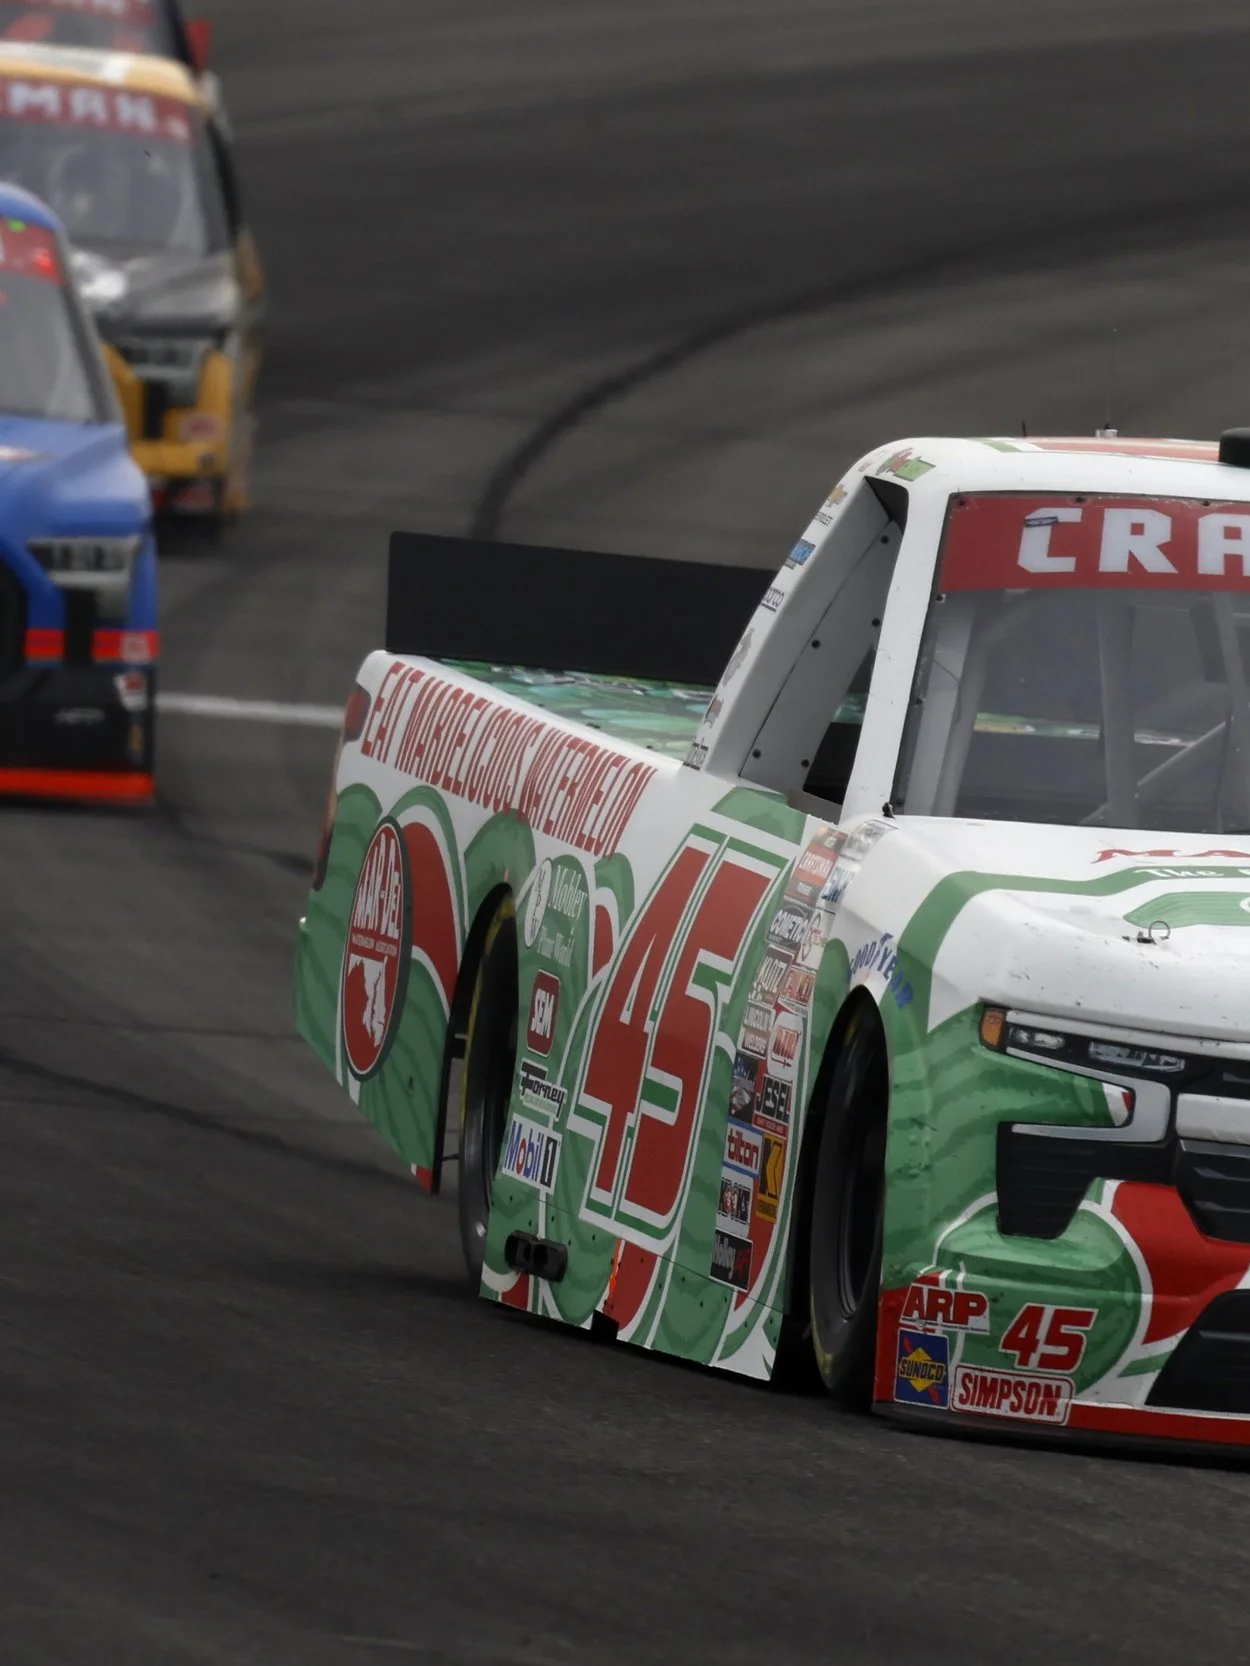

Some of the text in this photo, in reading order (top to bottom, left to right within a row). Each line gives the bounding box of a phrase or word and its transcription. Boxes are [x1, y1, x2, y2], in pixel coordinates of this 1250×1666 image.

[361, 661, 657, 859] EAT MARDELICIOUS WATERMELON
[354, 832, 400, 940] MAR-DEL
[1134, 868, 1224, 878] The
[531, 988, 554, 1039] SEM
[583, 846, 772, 1216] 45
[504, 1120, 559, 1188] Mobil 1
[902, 1285, 987, 1325] ARP
[1001, 1305, 1095, 1371] 45
[899, 1357, 945, 1382] SUNOCO
[959, 1372, 1062, 1417] SIMPSON
